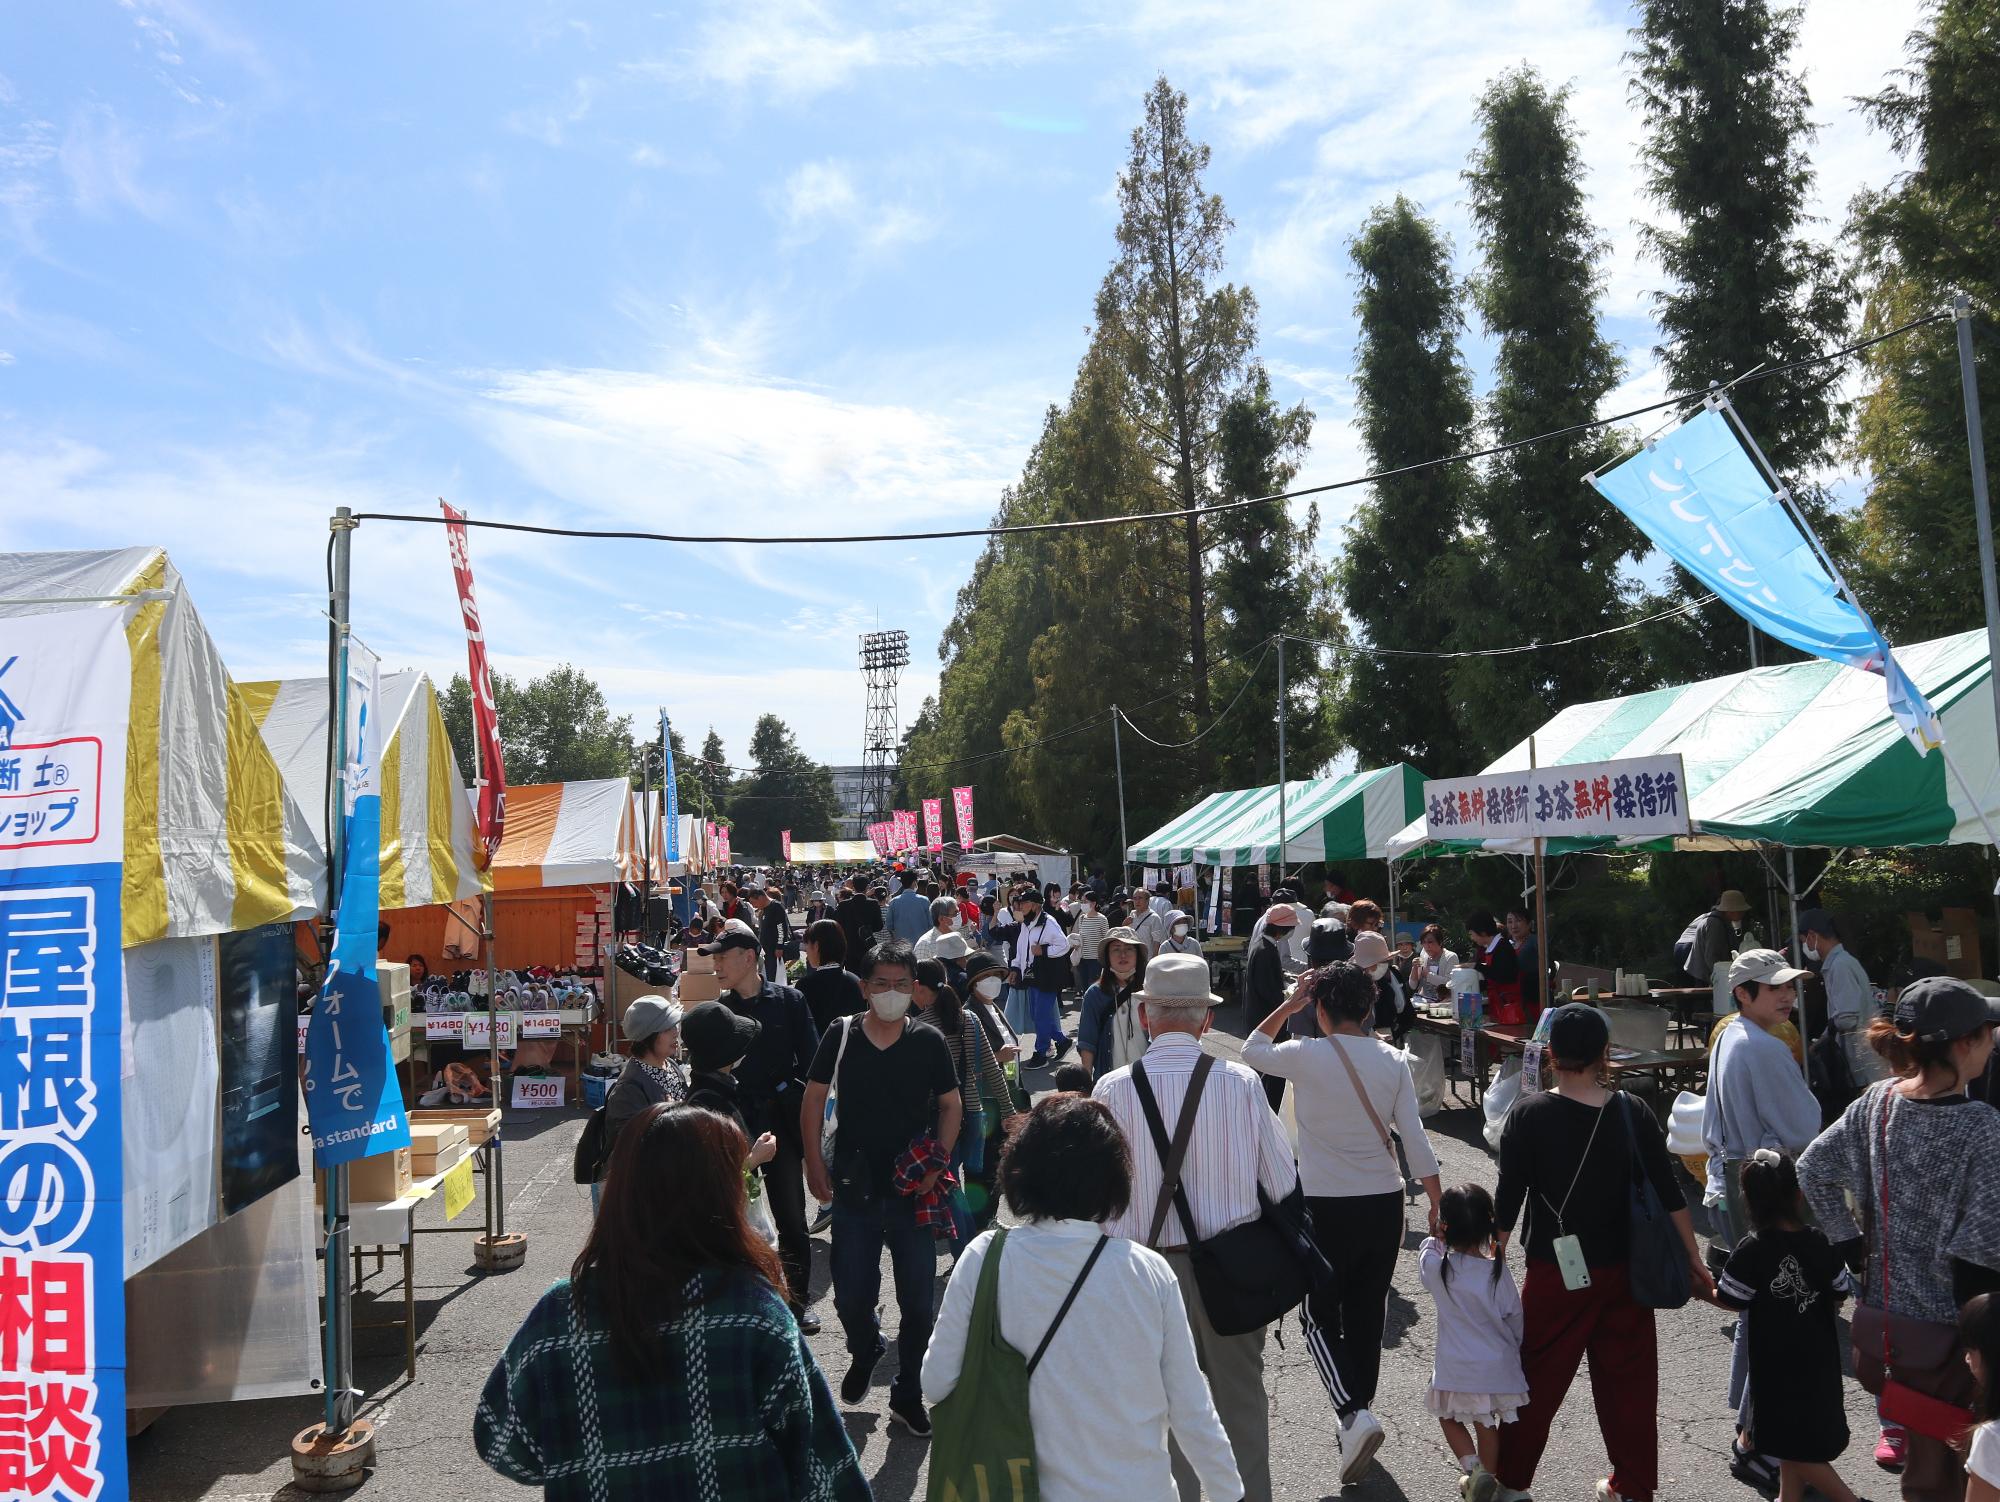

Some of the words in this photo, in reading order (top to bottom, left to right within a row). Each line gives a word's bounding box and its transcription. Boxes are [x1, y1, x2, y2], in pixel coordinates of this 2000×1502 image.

[1429, 785, 1530, 827] お茶無料接待所
[1535, 771, 1678, 822] お茶無料接待所
[427, 1020, 463, 1030] ¥1480
[524, 1019, 560, 1028] ¥1480
[520, 1083, 558, 1097] ¥500
[327, 1114, 398, 1146] standard
